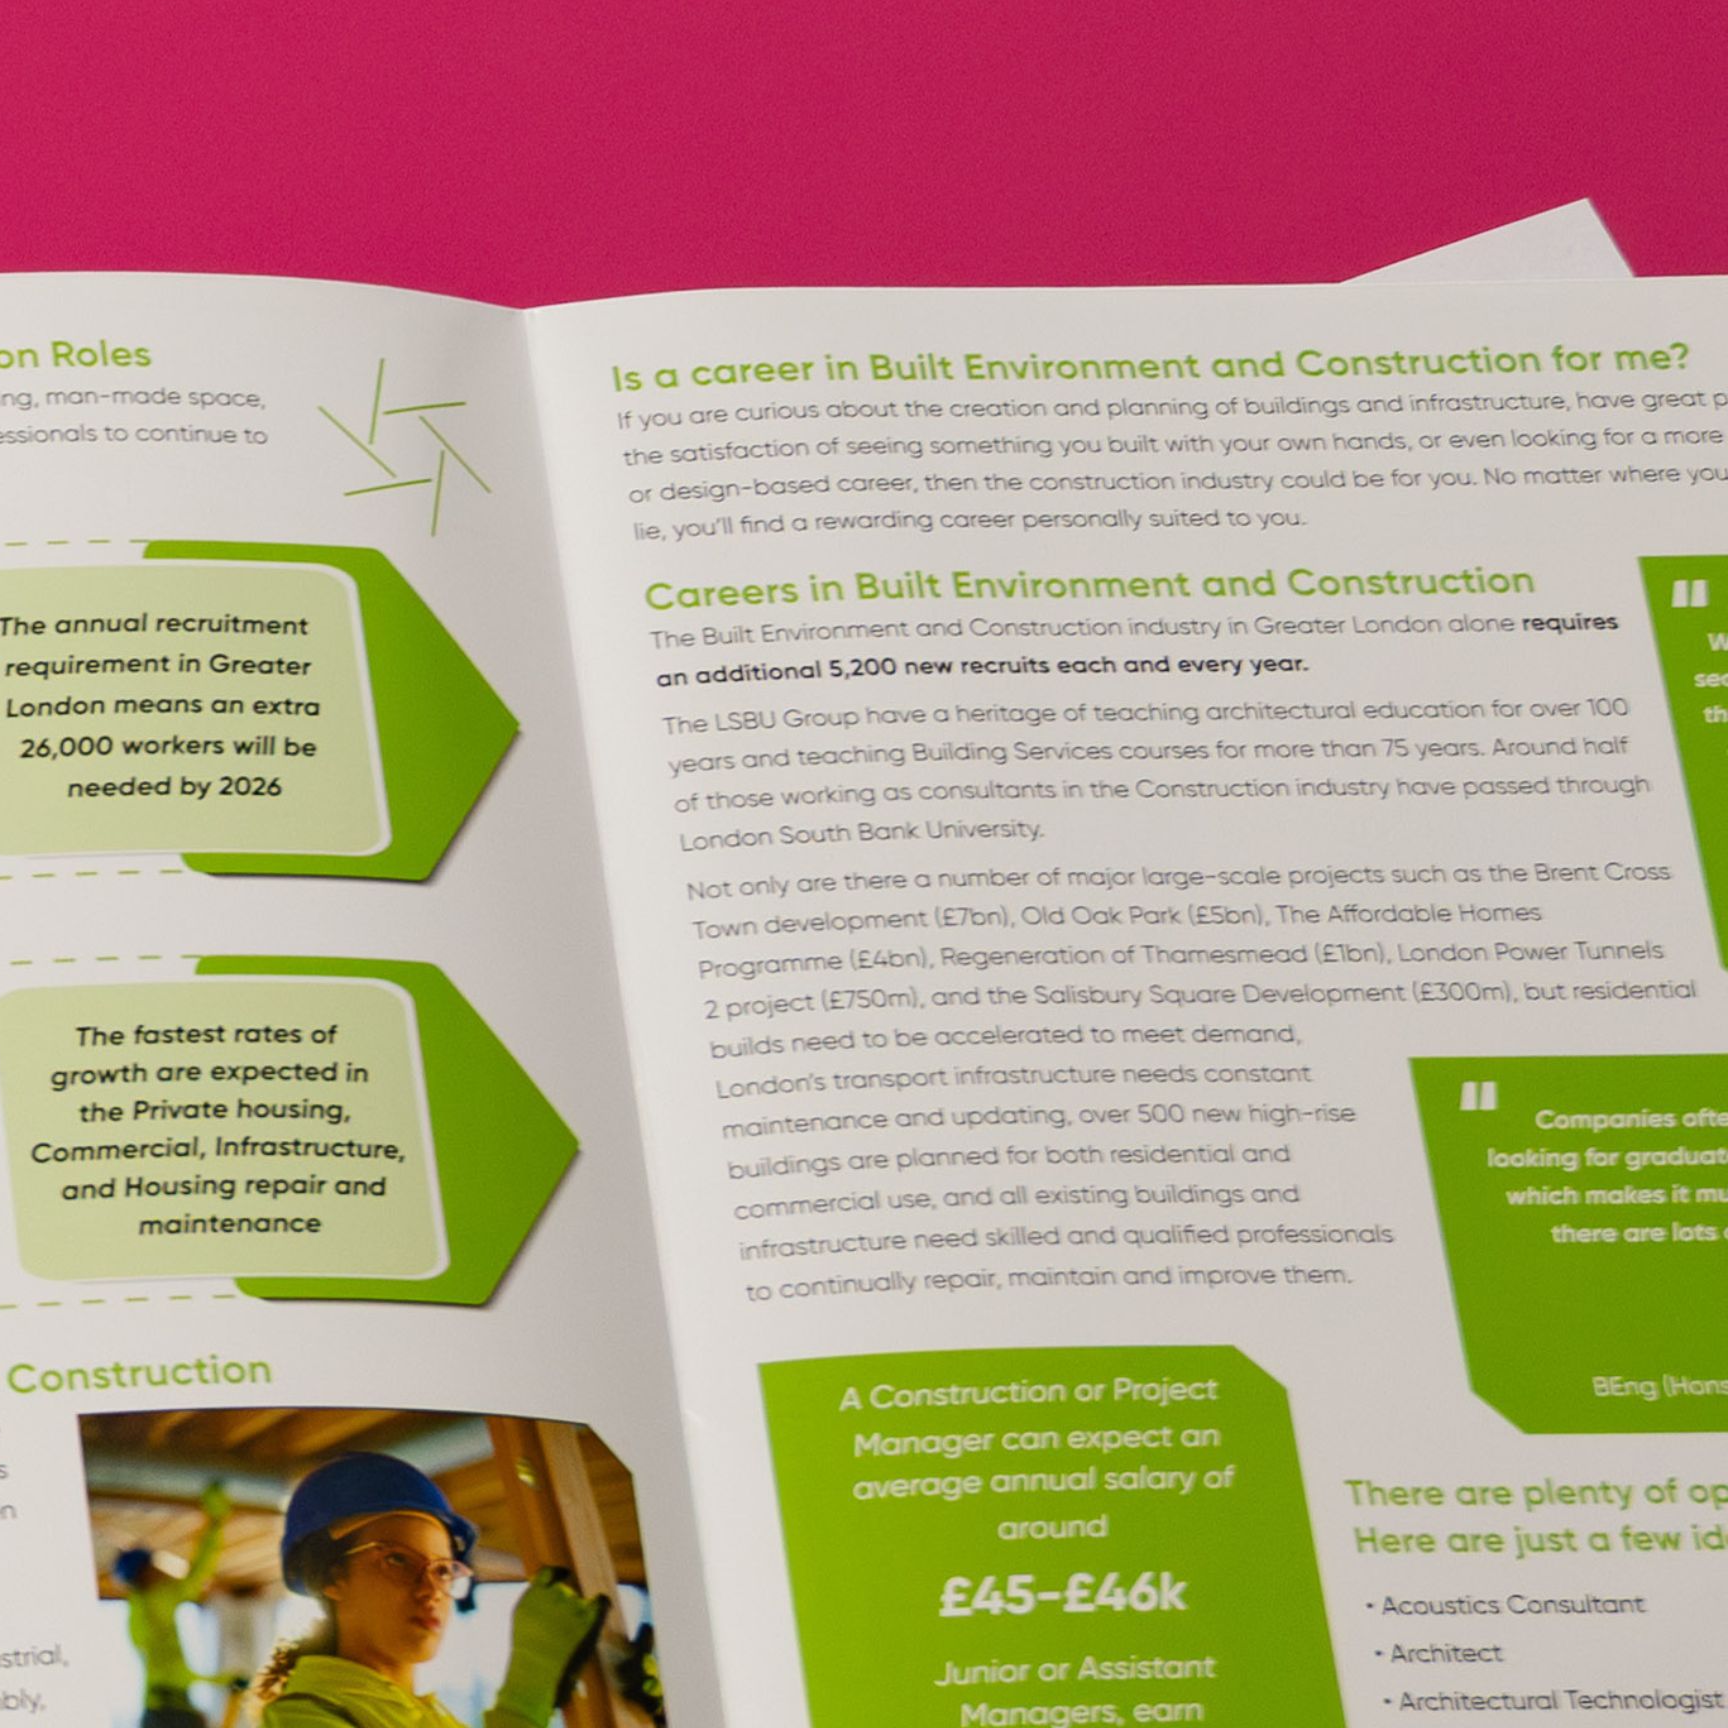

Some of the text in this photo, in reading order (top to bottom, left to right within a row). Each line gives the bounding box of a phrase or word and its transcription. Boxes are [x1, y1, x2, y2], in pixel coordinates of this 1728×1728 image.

[50, 338, 153, 369] Roles
[611, 340, 1691, 394] Is a career in Built Environment and Construction for me?
[186, 390, 267, 412] space,
[644, 565, 1536, 613] Careers in Built Environment and Construction
[53, 611, 149, 636] annual
[154, 612, 310, 637] recruitment
[4, 652, 313, 682] requirement in Greater
[5, 694, 322, 720] London means an extra
[18, 733, 318, 762] 26,000 workers will be
[66, 774, 284, 802] needed by 2026
[5, 1357, 273, 1396] Construction
[837, 1375, 1220, 1413] A Construction or Project
